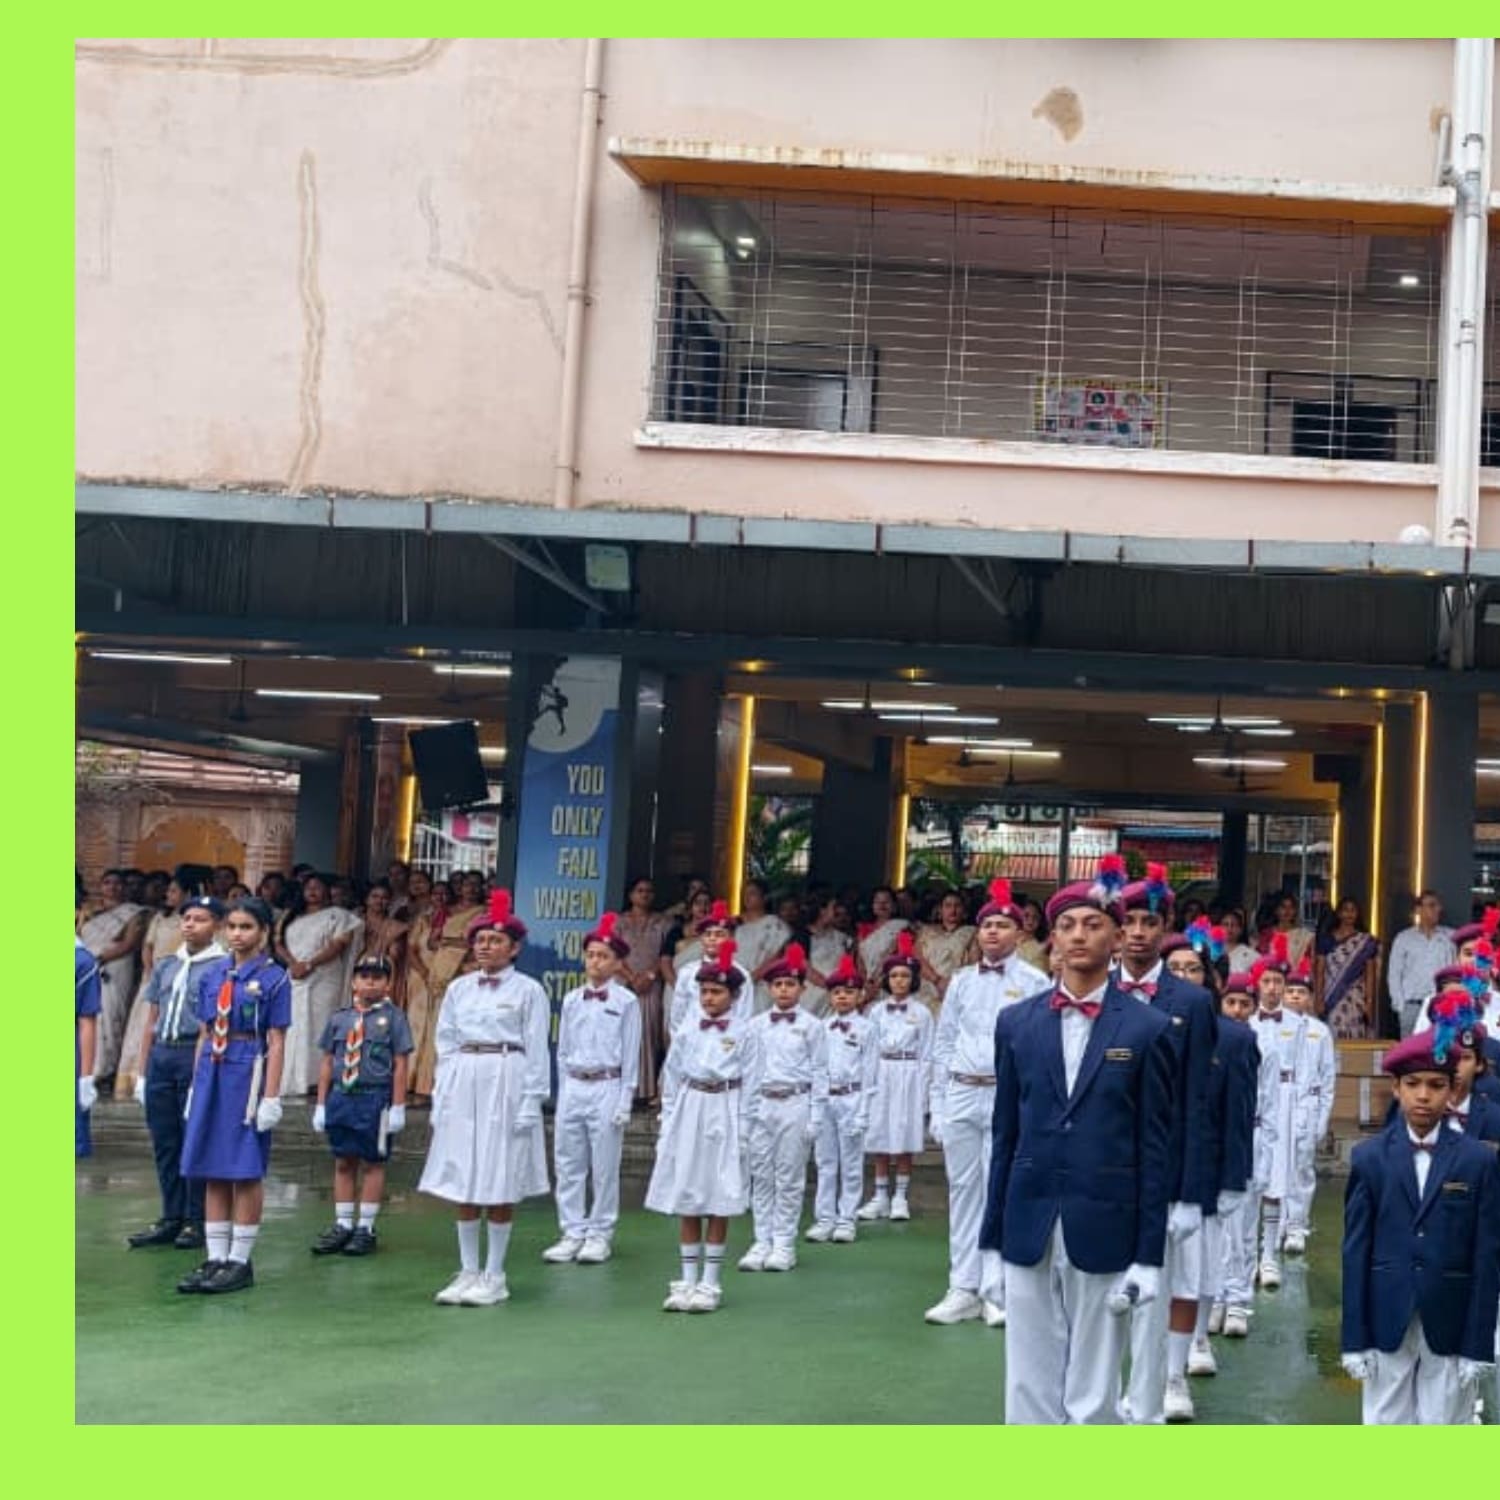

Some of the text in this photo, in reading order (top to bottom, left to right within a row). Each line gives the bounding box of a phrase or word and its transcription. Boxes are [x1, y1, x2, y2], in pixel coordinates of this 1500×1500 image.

[567, 764, 605, 796] YOU
[551, 804, 603, 838] ONLY
[557, 847, 600, 879] FAIL
[535, 888, 596, 920] WHEN
